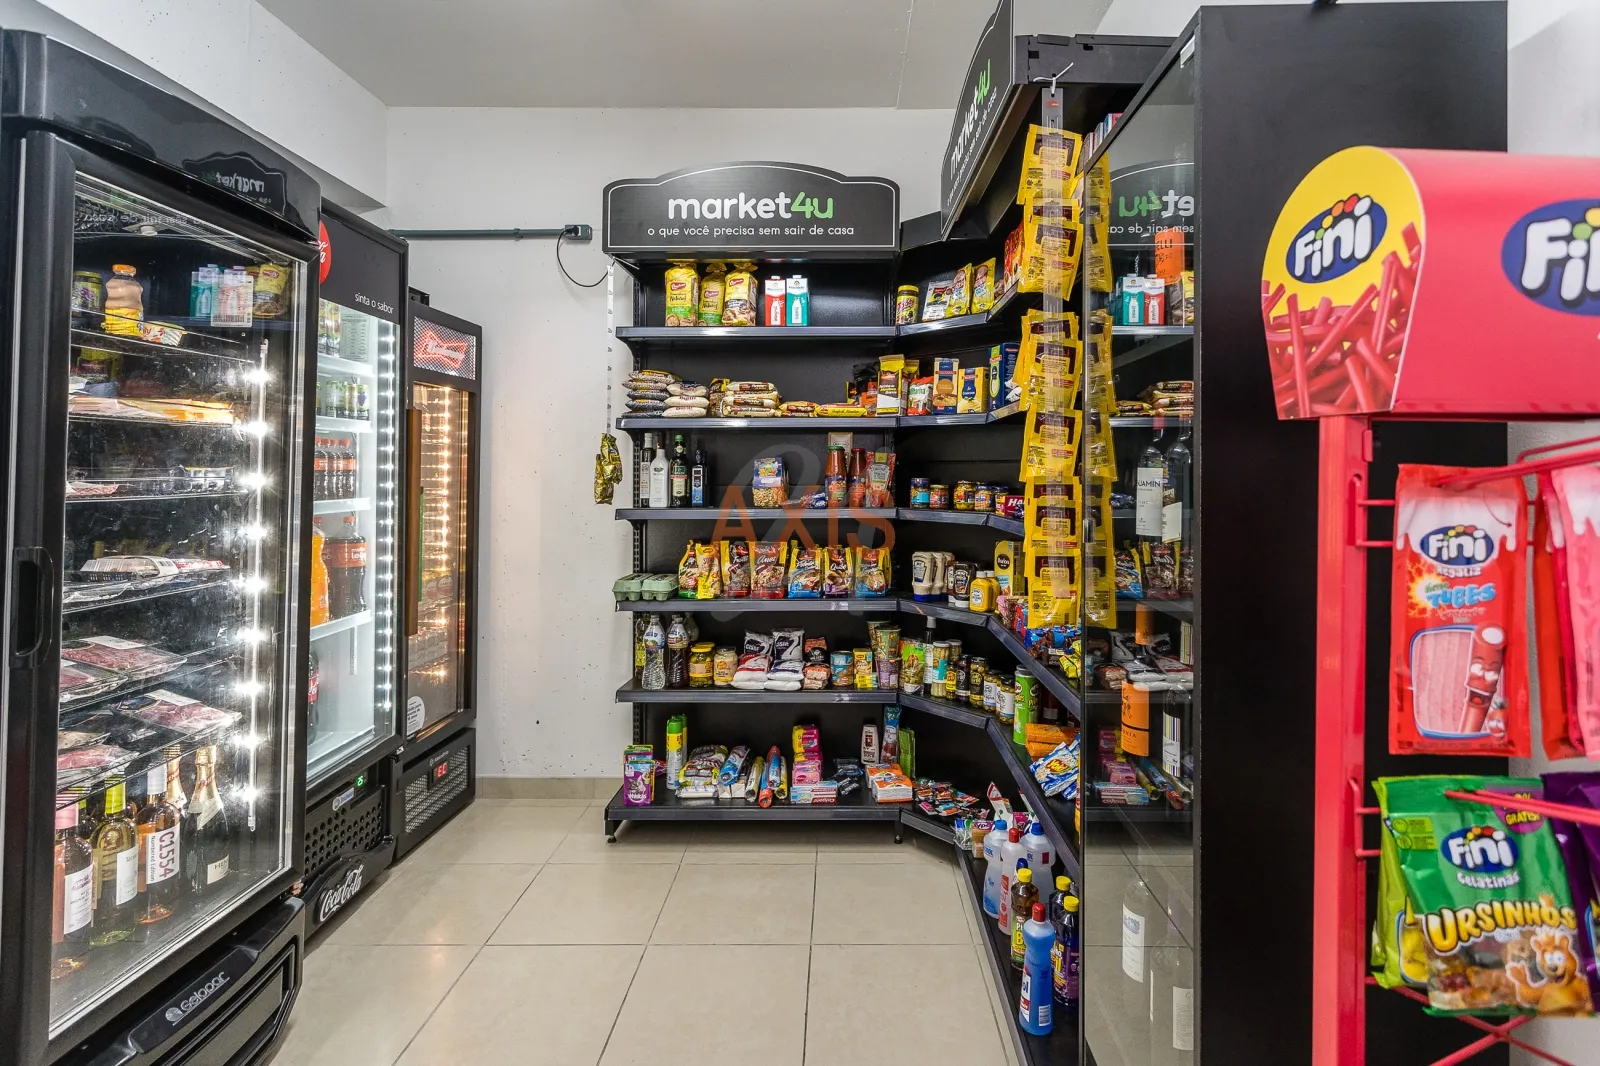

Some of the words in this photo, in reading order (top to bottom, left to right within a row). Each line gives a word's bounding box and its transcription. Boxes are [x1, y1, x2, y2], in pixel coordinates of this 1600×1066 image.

[950, 58, 991, 181] market4u
[668, 191, 834, 219] market4u
[647, 227, 655, 236] o
[658, 227, 680, 238] que
[683, 225, 710, 236] você
[713, 225, 755, 238] precisa
[758, 227, 781, 236] sem
[784, 225, 806, 236] sair
[809, 224, 824, 236] de
[827, 227, 855, 236] casa
[1294, 196, 1373, 277] Fini
[354, 292, 370, 306] sinta
[371, 299, 377, 308] o
[377, 300, 394, 314] sabor
[1428, 528, 1488, 561] Fini
[159, 831, 175, 878] C1554
[1447, 830, 1515, 869] Fini
[1456, 872, 1520, 889] Gelatinas
[1426, 901, 1578, 953] URSINHOS
[180, 971, 230, 1013] Gelopar
